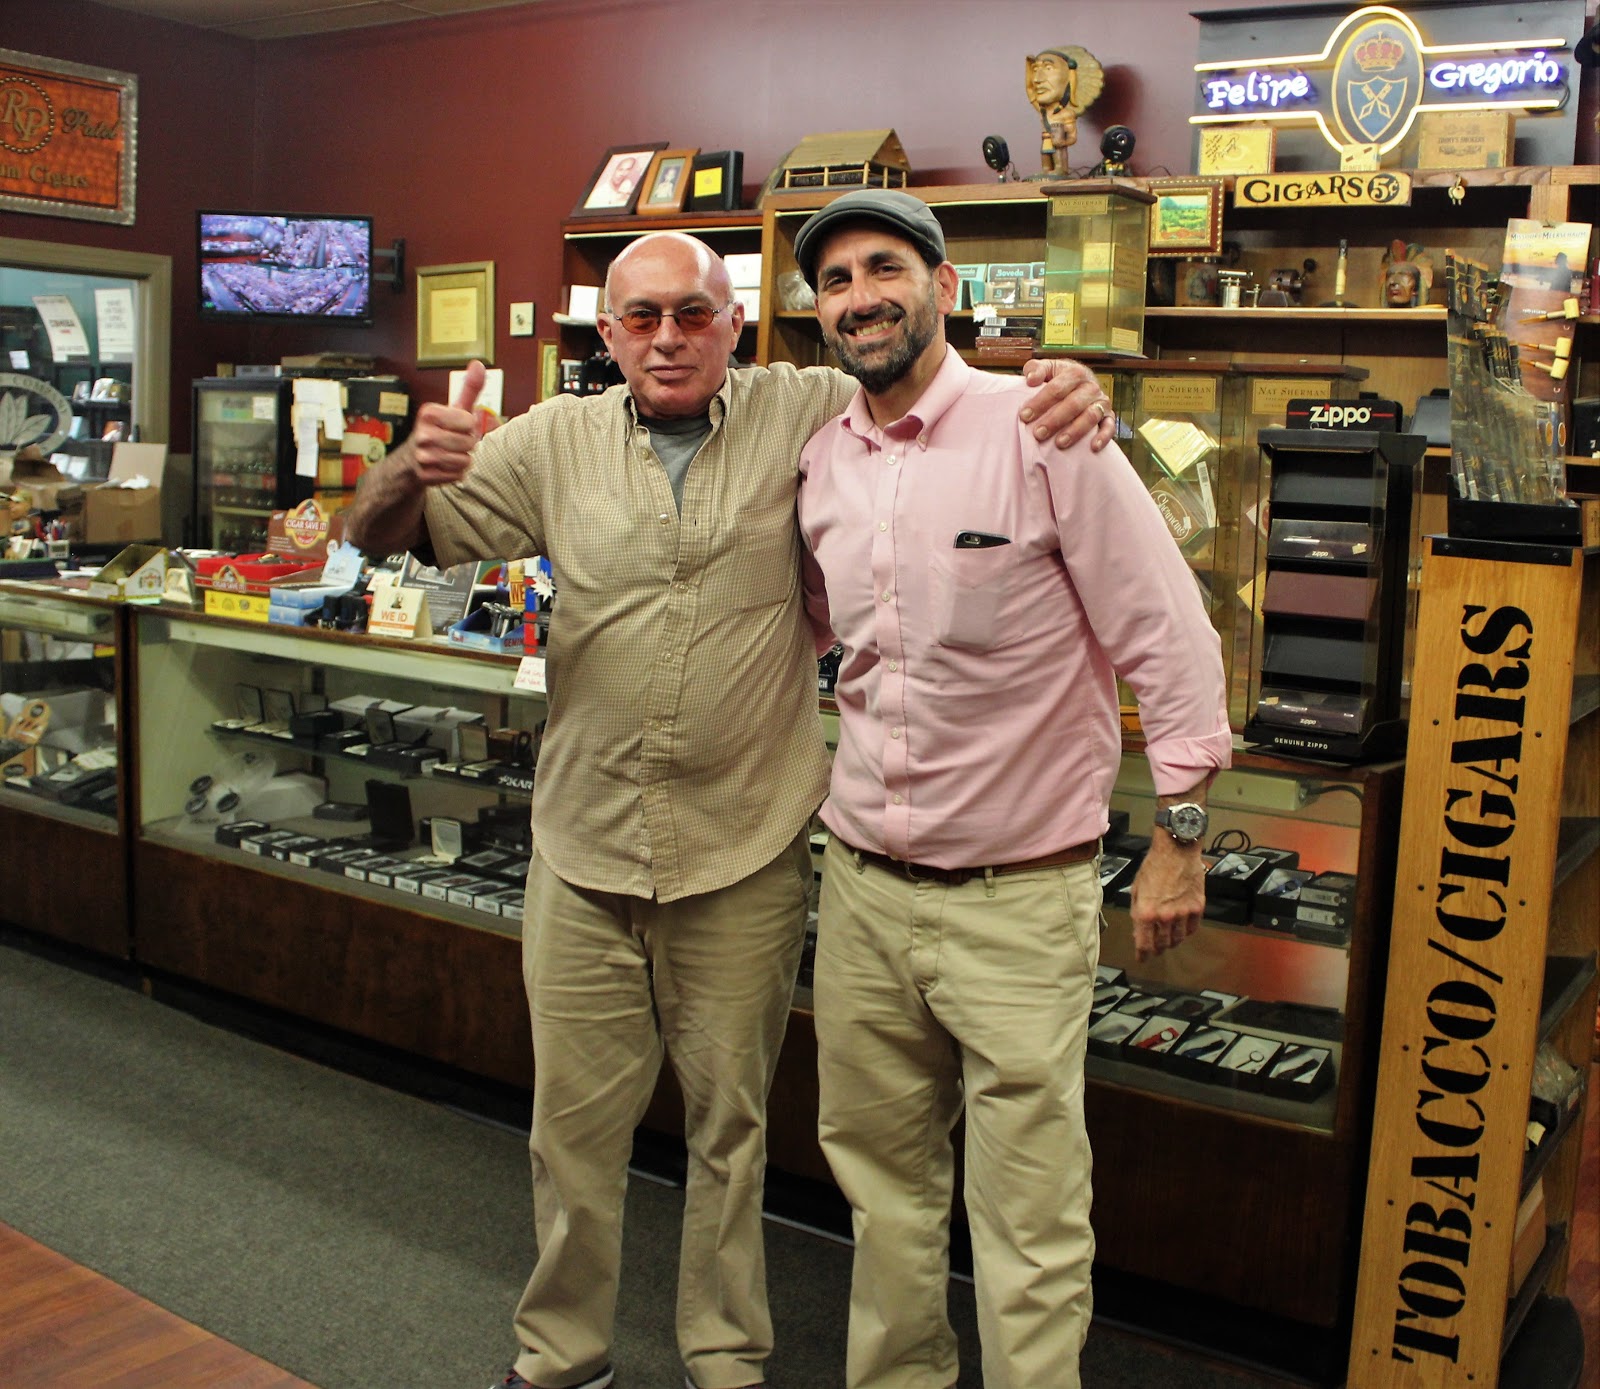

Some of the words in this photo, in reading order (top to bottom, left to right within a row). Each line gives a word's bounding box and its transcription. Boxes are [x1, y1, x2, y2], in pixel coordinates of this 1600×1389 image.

[1206, 70, 1309, 108] Felipe
[1429, 51, 1560, 94] Gregorio
[29, 164, 89, 187] Cigars
[1243, 175, 1364, 204] CIGARS
[996, 268, 1024, 277] Boveda
[1147, 384, 1165, 393] NAT
[1168, 384, 1212, 393] SHERMAN
[1258, 386, 1277, 395] NAT
[1281, 387, 1327, 396] SHERMAN
[285, 519, 304, 529] CIGAR
[305, 520, 318, 530] SAVE
[382, 610, 396, 621] WE
[398, 611, 408, 622] ID
[1274, 737, 1305, 747] GENUINE
[1307, 741, 1328, 750] ZIPPO
[1392, 605, 1534, 1364] TOBACCO/CIGARS
